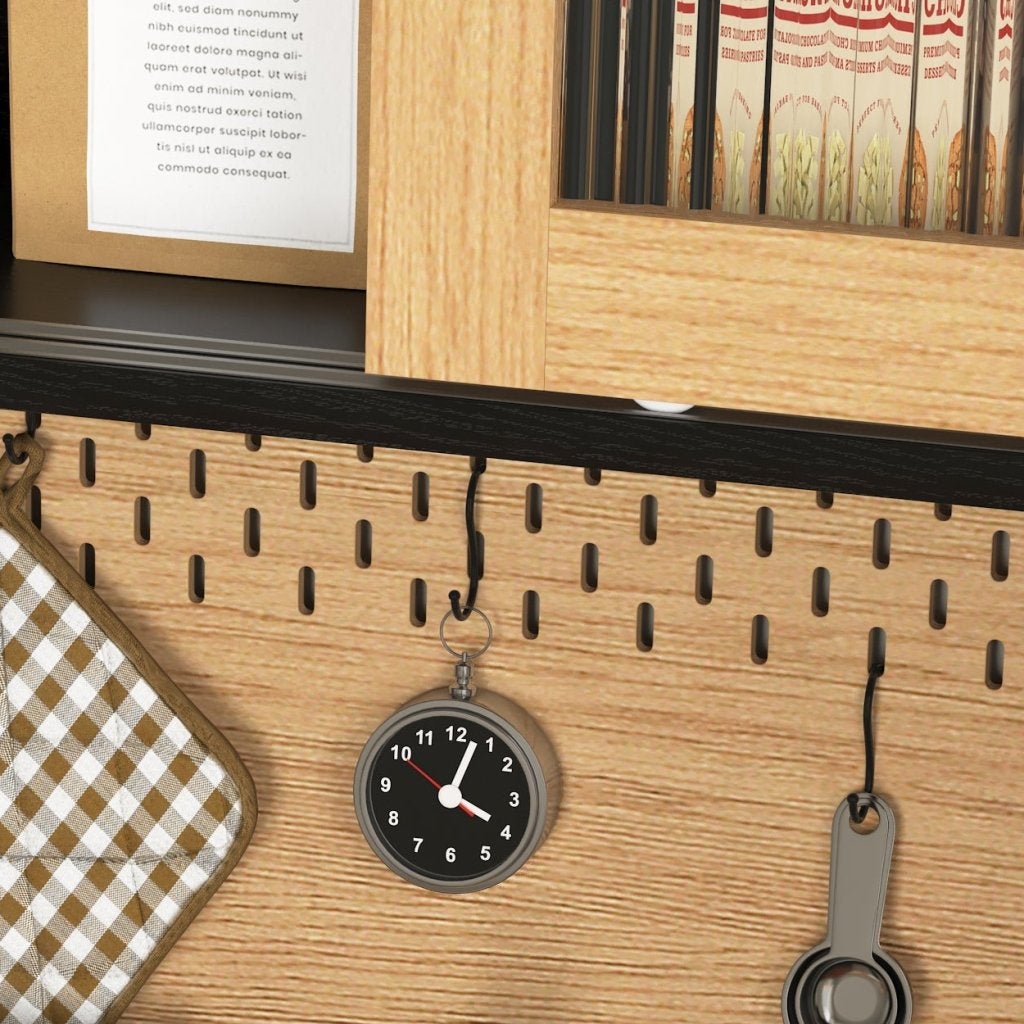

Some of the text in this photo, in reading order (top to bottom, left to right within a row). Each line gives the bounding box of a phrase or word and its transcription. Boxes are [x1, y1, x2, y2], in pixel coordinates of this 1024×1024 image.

[178, 4, 199, 14] sed
[203, 5, 234, 16] diam
[238, 9, 299, 22] nonummy
[148, 22, 303, 41] nibh euismod tincidunt ut
[147, 42, 303, 60] laoreet dolore magna ali-
[144, 62, 178, 73] quam
[182, 64, 207, 74] erat
[211, 66, 264, 79] volutpat.
[284, 71, 307, 81] wisi
[154, 82, 184, 92] enim
[188, 84, 203, 94] ad
[207, 86, 244, 96] minim
[147, 101, 303, 120] quis nostrud exerci tation
[142, 121, 215, 135] ullamcorper
[219, 126, 266, 139] suscipit
[156, 142, 292, 160] tis nisl ut aliquip ex ea
[157, 162, 219, 175] commodo
[416, 729, 433, 746] 11
[445, 725, 467, 743] 12
[390, 744, 412, 762] 10
[485, 737, 494, 753] 1
[502, 757, 513, 773] 2
[380, 777, 391, 793] 9
[509, 792, 520, 807] 3
[388, 810, 399, 826] 8
[500, 825, 512, 840] 4
[413, 837, 424, 853] 7
[445, 847, 456, 863] 6
[480, 846, 491, 861] 5
